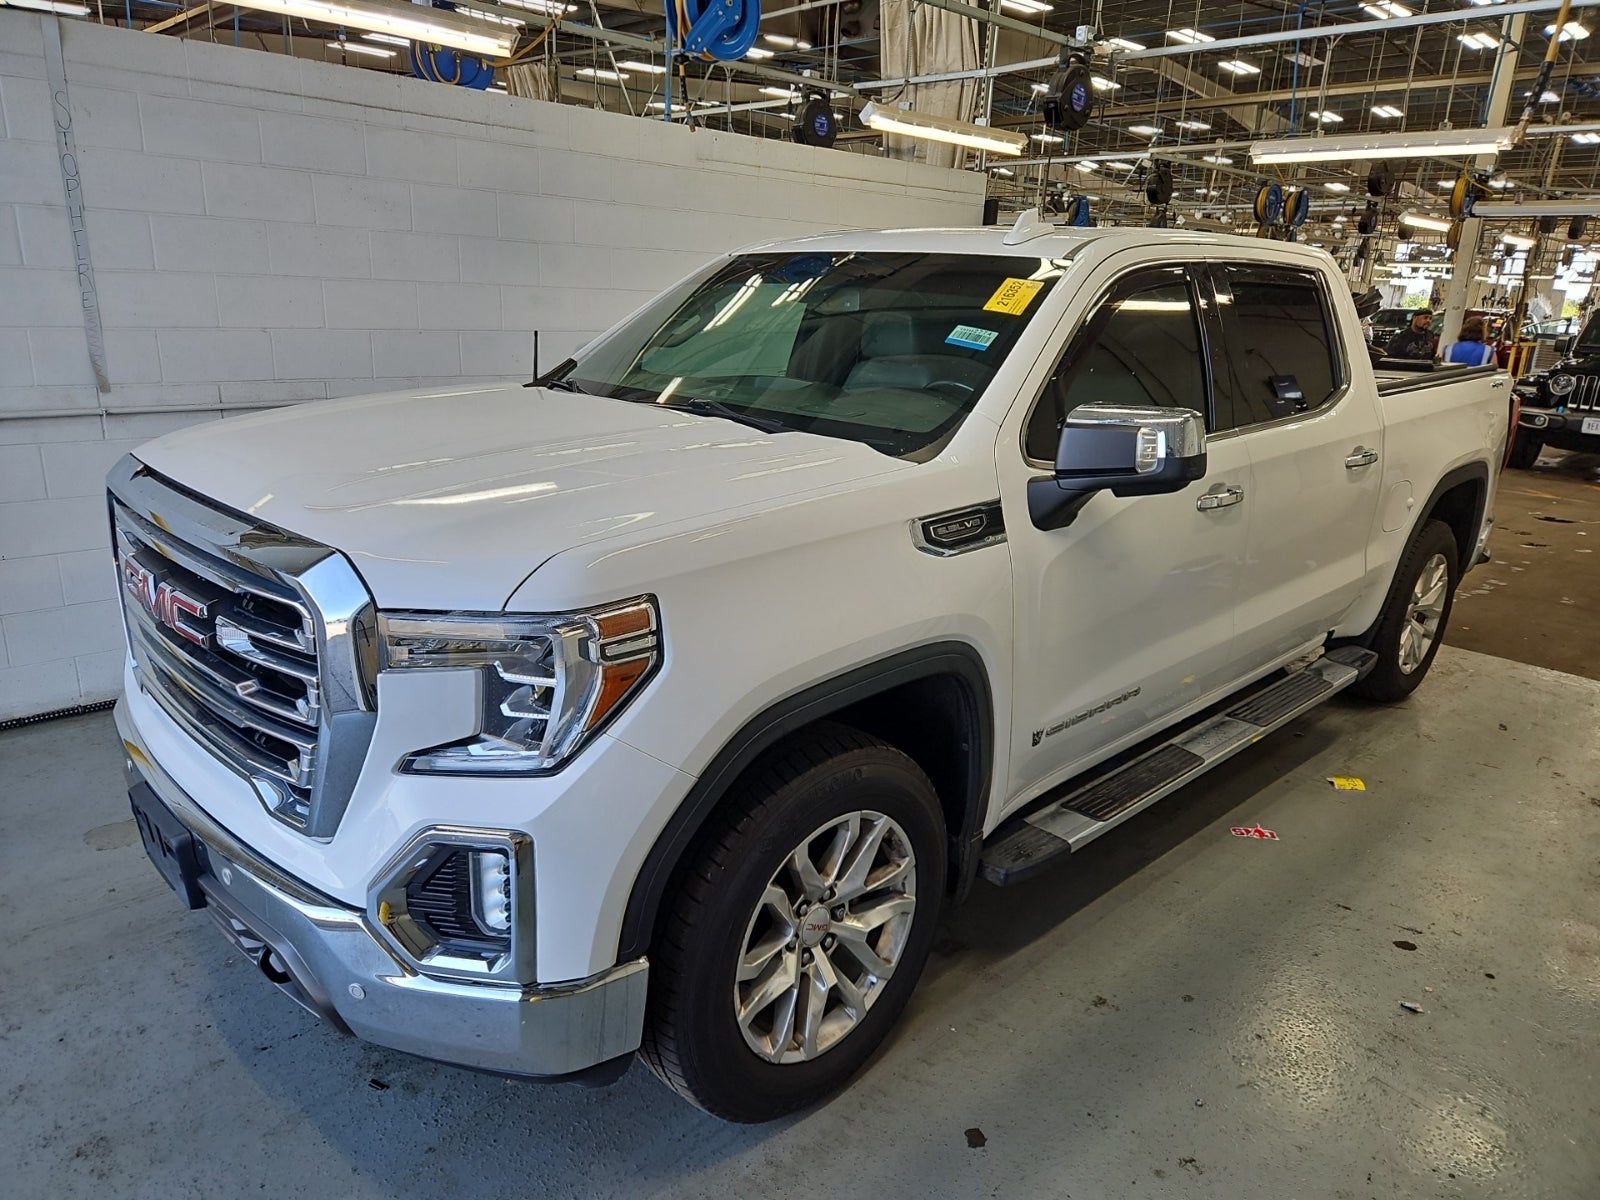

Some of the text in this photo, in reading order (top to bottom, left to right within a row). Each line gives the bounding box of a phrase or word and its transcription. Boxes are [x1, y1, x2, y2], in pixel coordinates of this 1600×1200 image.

[54, 90, 94, 309] STOP HERE
[996, 280, 1025, 307] 216352
[124, 554, 208, 647] GMC
[806, 923, 831, 932] GMC
